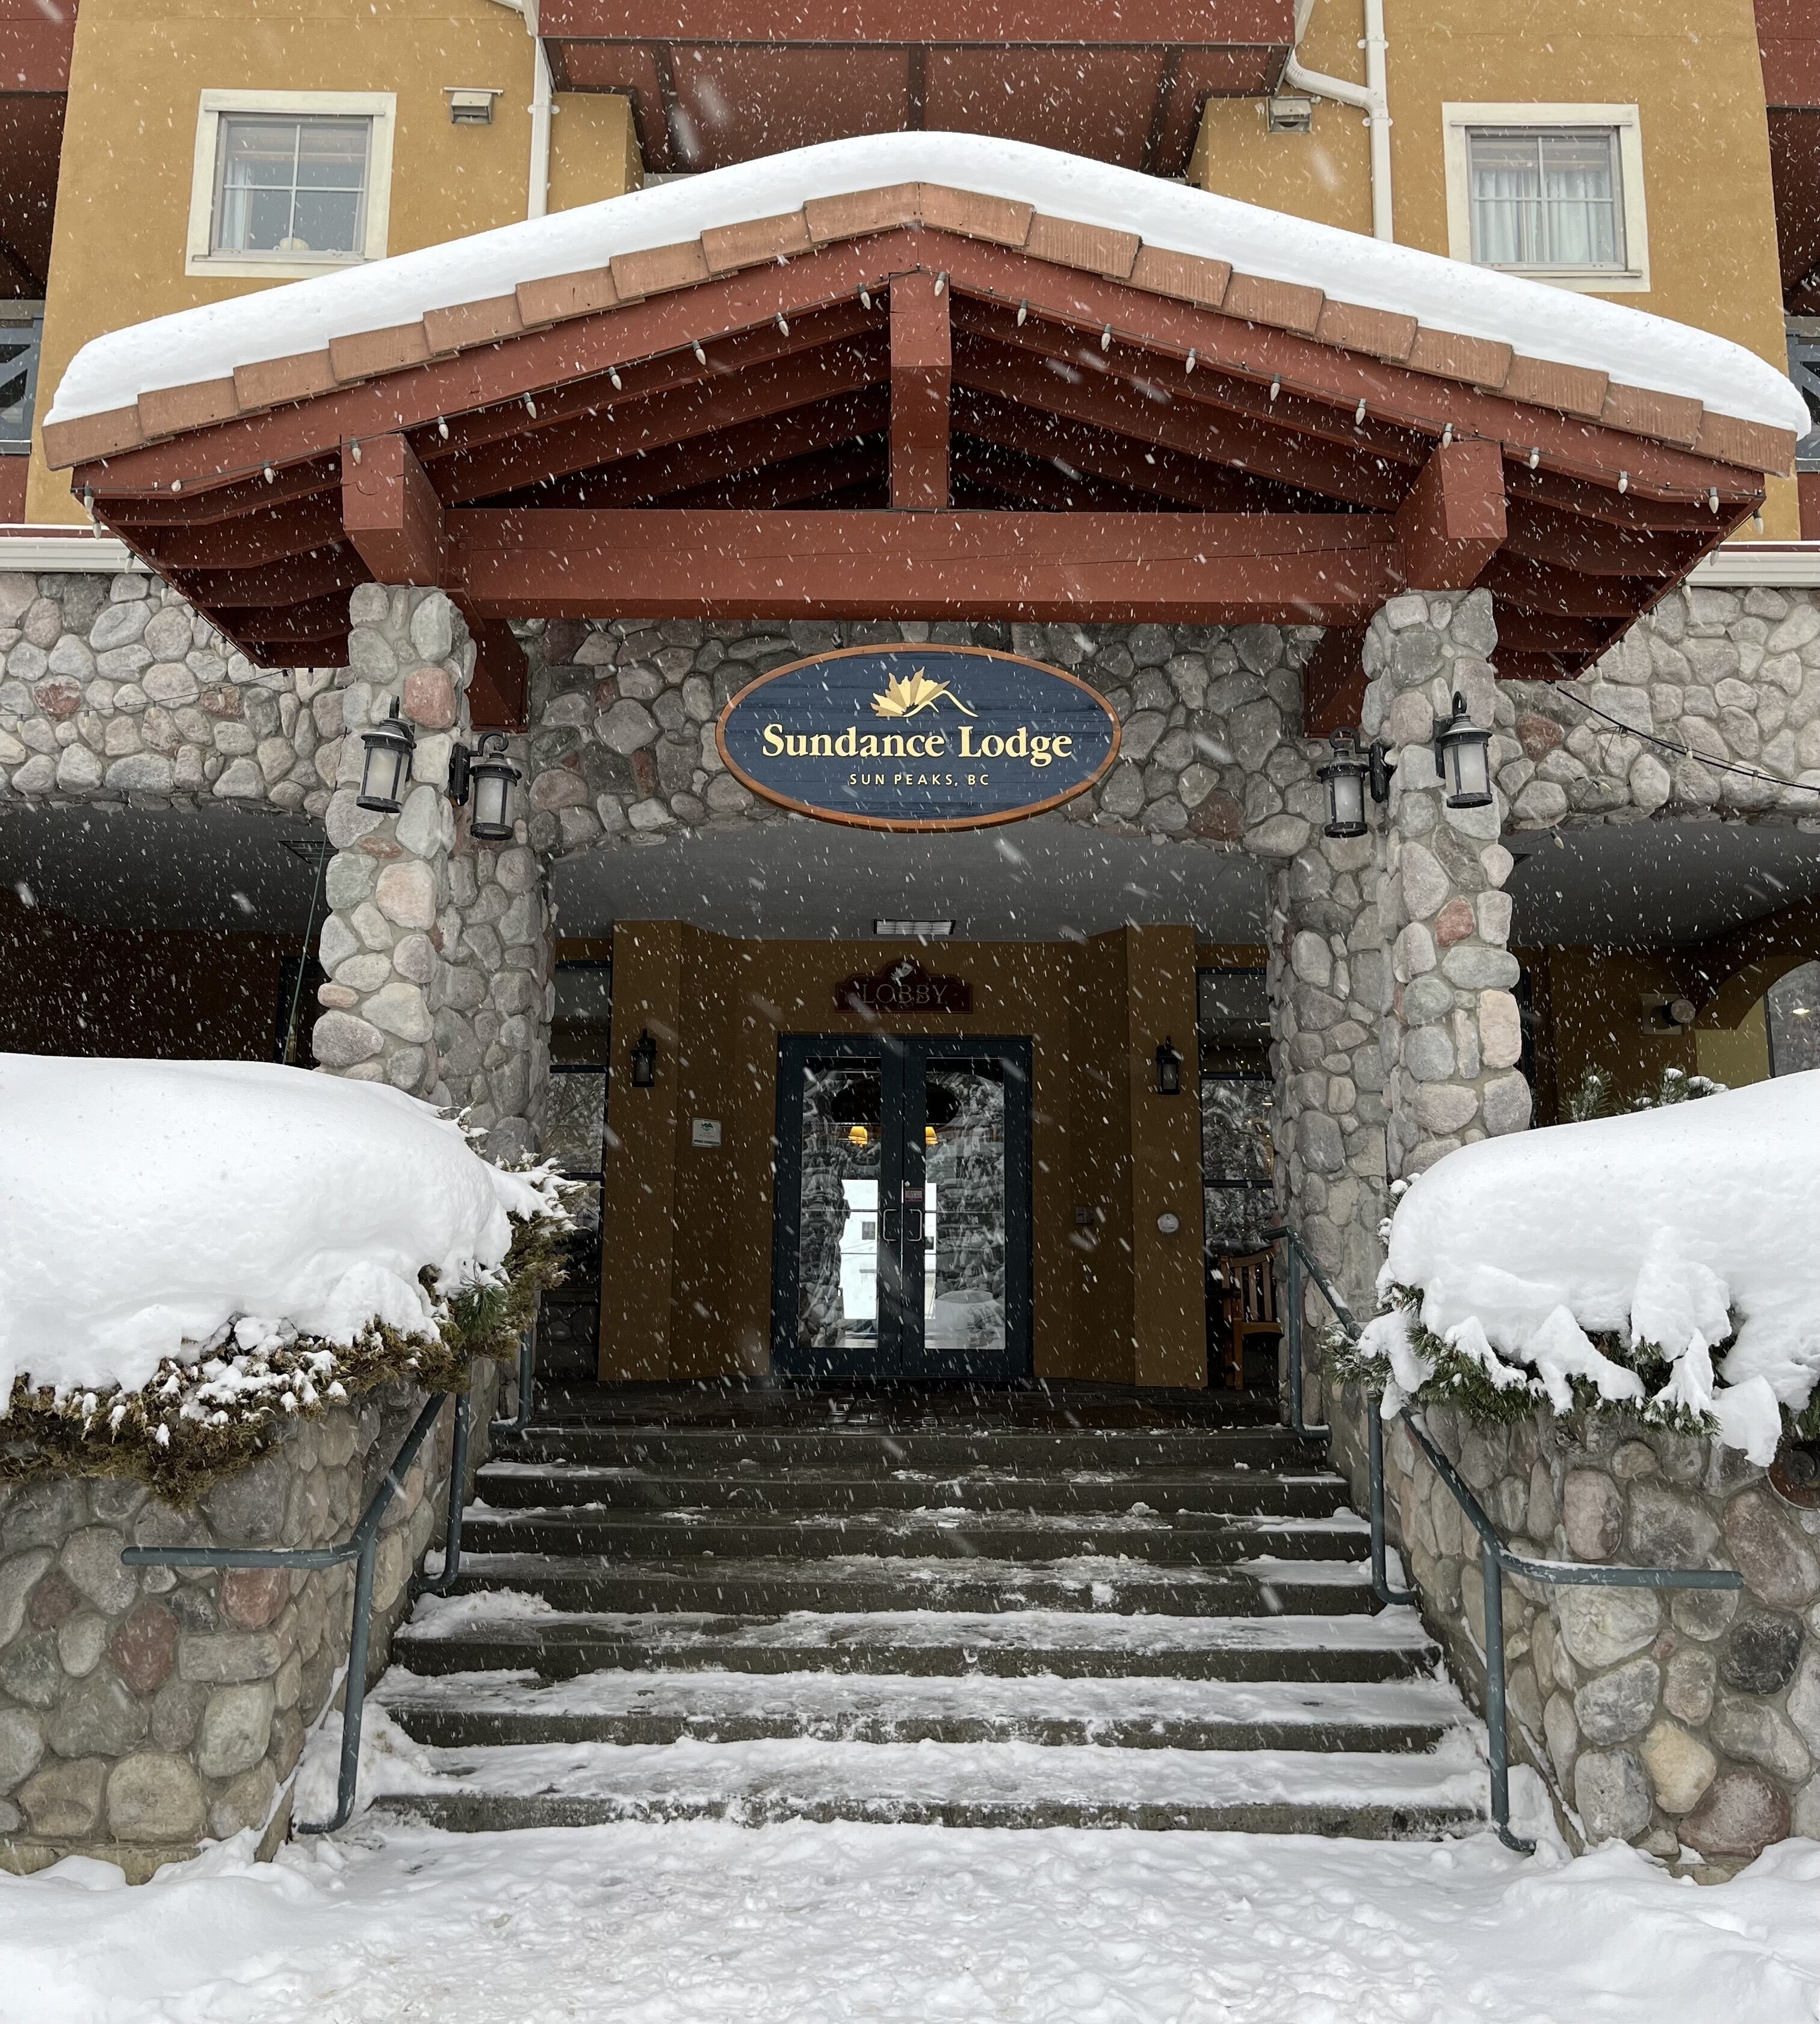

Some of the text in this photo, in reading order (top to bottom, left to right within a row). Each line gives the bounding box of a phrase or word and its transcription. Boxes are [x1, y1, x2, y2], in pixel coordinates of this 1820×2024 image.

[763, 723, 1072, 767] Sundance Lodge
[849, 774, 989, 787] SUN PEAKS, BC
[862, 983, 947, 1004] LOBBY
